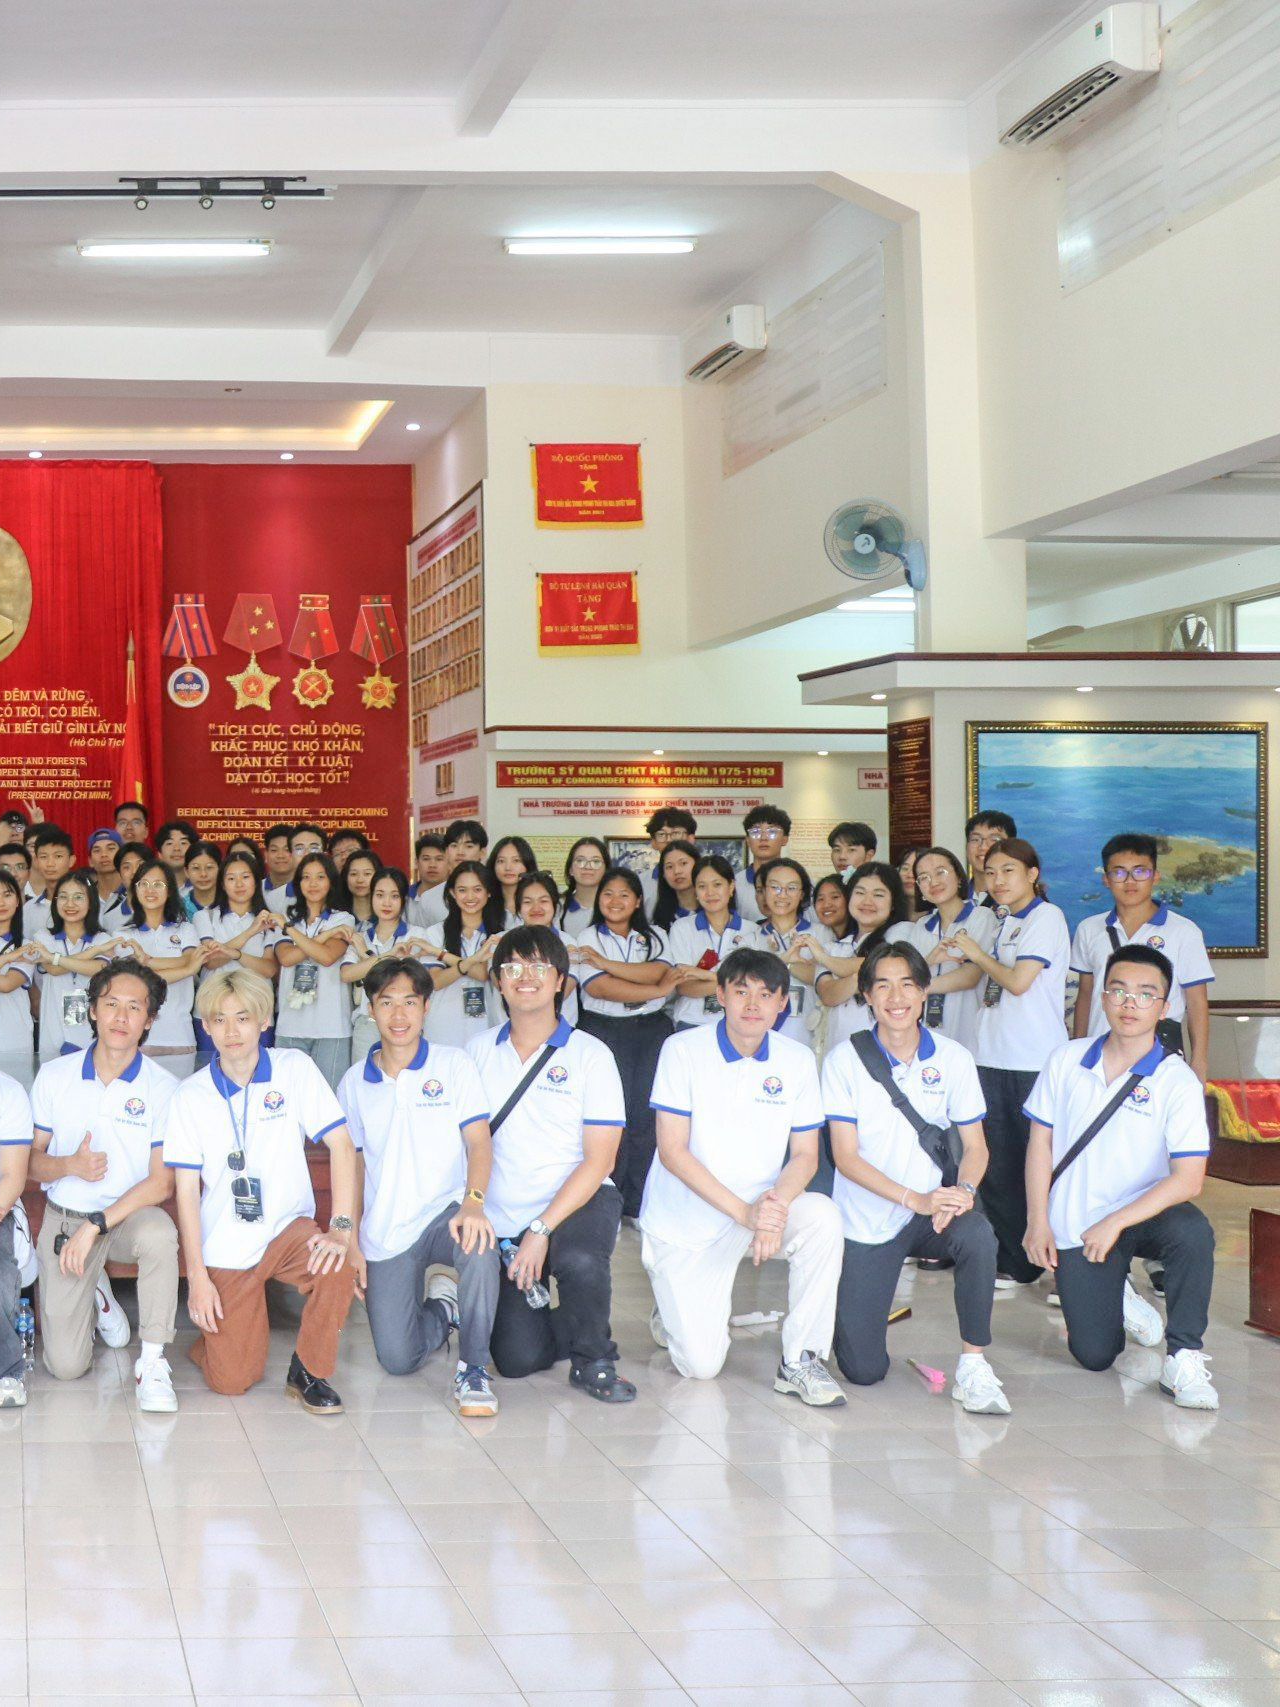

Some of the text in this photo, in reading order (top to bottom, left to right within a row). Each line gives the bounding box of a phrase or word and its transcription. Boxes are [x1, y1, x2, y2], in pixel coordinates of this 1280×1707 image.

[4, 687, 30, 701] ĐÊM
[33, 687, 48, 701] VÀ
[49, 704, 67, 718] CÓ
[14, 720, 38, 734] BIẾT
[41, 720, 64, 733] GIỮ
[66, 719, 87, 733] GÌN
[290, 720, 317, 736] CHỦ
[322, 722, 365, 738] ĐỘNG,
[211, 737, 247, 752] KHẮC
[253, 740, 288, 754] PHỤC
[293, 738, 319, 752] KHÓ
[26, 756, 44, 765] AND
[46, 756, 88, 767] FORESTS,
[223, 754, 261, 768] ĐOÀN
[298, 752, 315, 767] KỶ
[21, 768, 38, 776] SKY
[40, 768, 58, 776] AND
[578, 766, 612, 776] QUAN
[615, 766, 647, 776] CHKT
[650, 763, 671, 776] HẢI
[0, 779, 18, 788] AND
[21, 779, 35, 788] WE
[36, 779, 60, 788] MUST
[62, 779, 101, 788] PROTECT
[103, 779, 112, 788] IT
[225, 771, 251, 786] DẠY
[286, 772, 315, 786] HỌC
[514, 777, 549, 785] SCHOOL
[565, 777, 626, 785] COMMANDER
[628, 777, 655, 785] NAVAL
[658, 777, 719, 785] ENGINEERING
[8, 791, 58, 800] (PRESIDENT
[59, 791, 71, 799] HO
[73, 791, 87, 799] CHI
[320, 808, 389, 816] OVERCOMING
